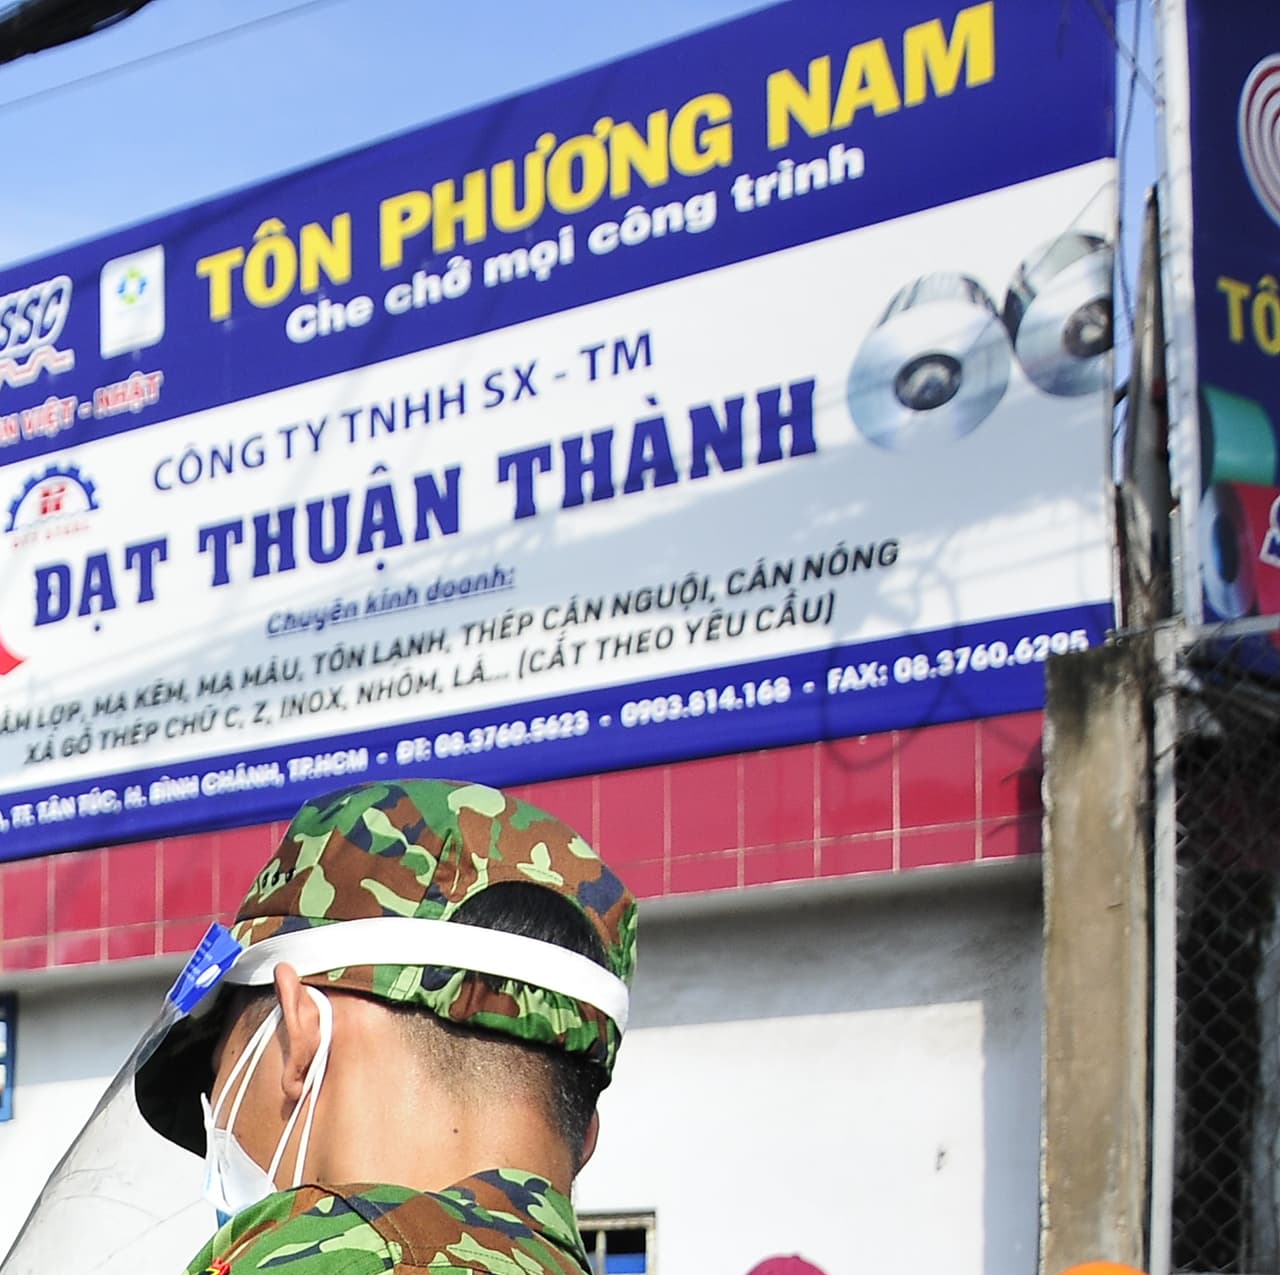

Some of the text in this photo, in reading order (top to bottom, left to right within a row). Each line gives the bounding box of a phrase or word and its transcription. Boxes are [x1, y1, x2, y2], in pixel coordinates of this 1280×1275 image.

[197, 0, 995, 323] TÔN PHƯƠNG NAM
[285, 143, 864, 344] Che chở mọi công trình
[153, 432, 266, 492] CÔNG
[279, 416, 329, 461] TY
[341, 381, 466, 444] TNHH
[483, 360, 538, 411] SX
[580, 331, 653, 383] TM
[33, 376, 819, 632] ĐẠT THUẬN THÀNH
[265, 599, 359, 638] Chuyên
[425, 567, 515, 604] doanh:
[461, 607, 534, 648] THÉP
[542, 593, 603, 632] CÁN
[726, 556, 794, 598] CÁN
[801, 538, 901, 582] NÓNG
[280, 685, 349, 719] INOX,
[596, 623, 675, 662] THEO
[684, 608, 747, 645] YÊU
[827, 661, 889, 696] FAX:
